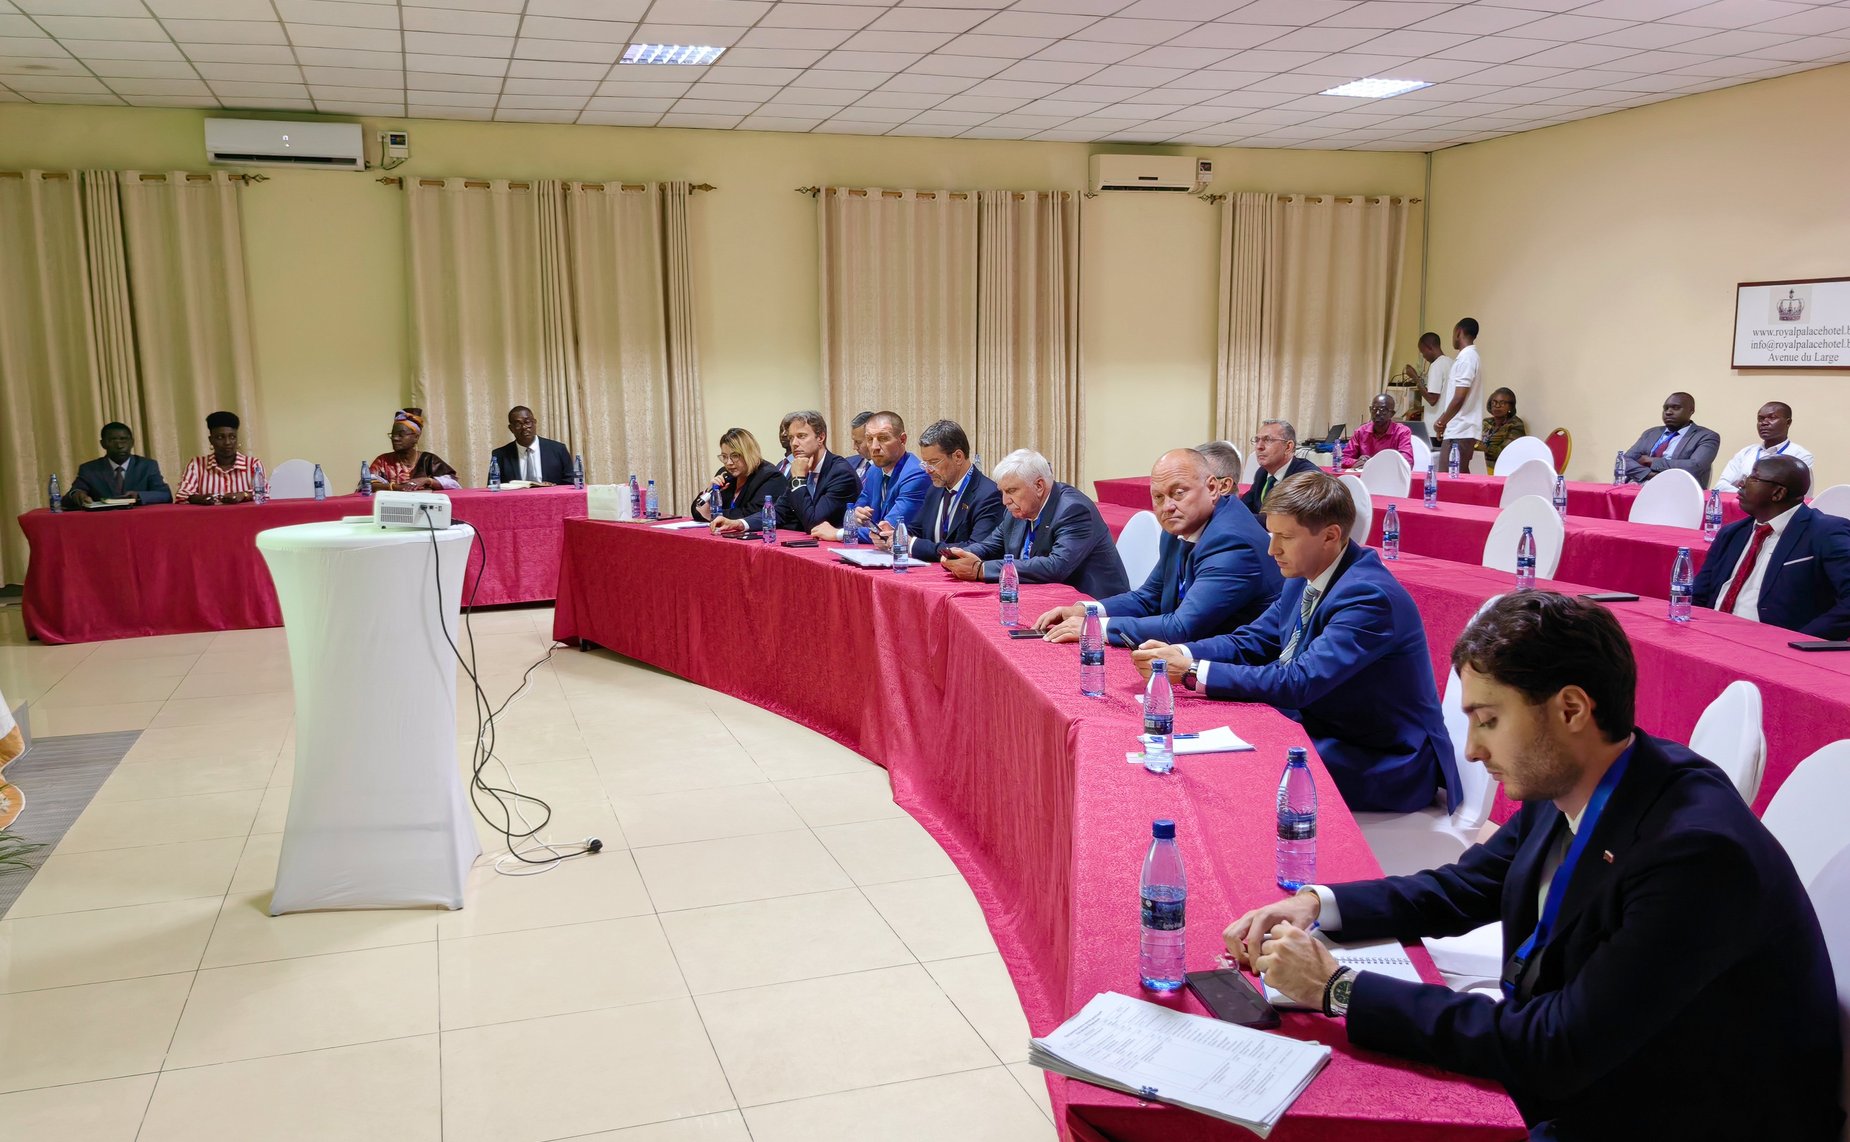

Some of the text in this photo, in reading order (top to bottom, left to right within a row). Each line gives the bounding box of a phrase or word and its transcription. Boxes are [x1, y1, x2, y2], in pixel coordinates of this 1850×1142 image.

[1768, 352, 1840, 364] Avenue du Large
